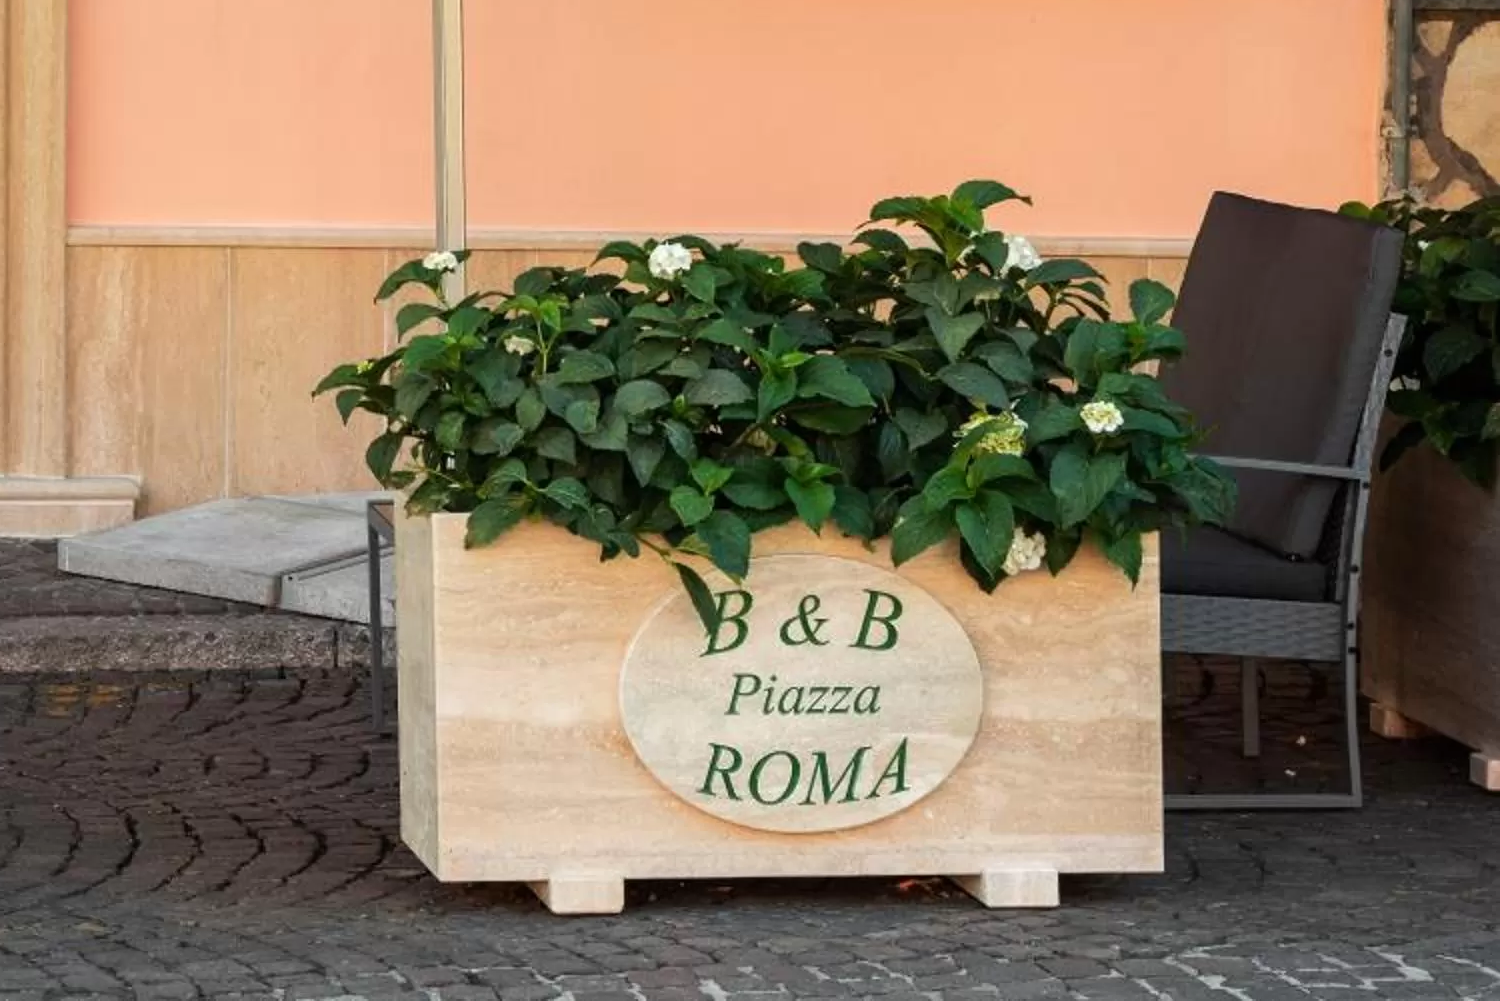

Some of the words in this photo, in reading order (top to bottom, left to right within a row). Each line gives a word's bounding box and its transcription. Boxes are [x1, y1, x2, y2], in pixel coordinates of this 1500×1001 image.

[700, 589, 754, 658] B
[779, 594, 829, 647] &
[848, 588, 904, 651] B
[724, 672, 882, 716] Piazza
[697, 736, 911, 806] ROMA
